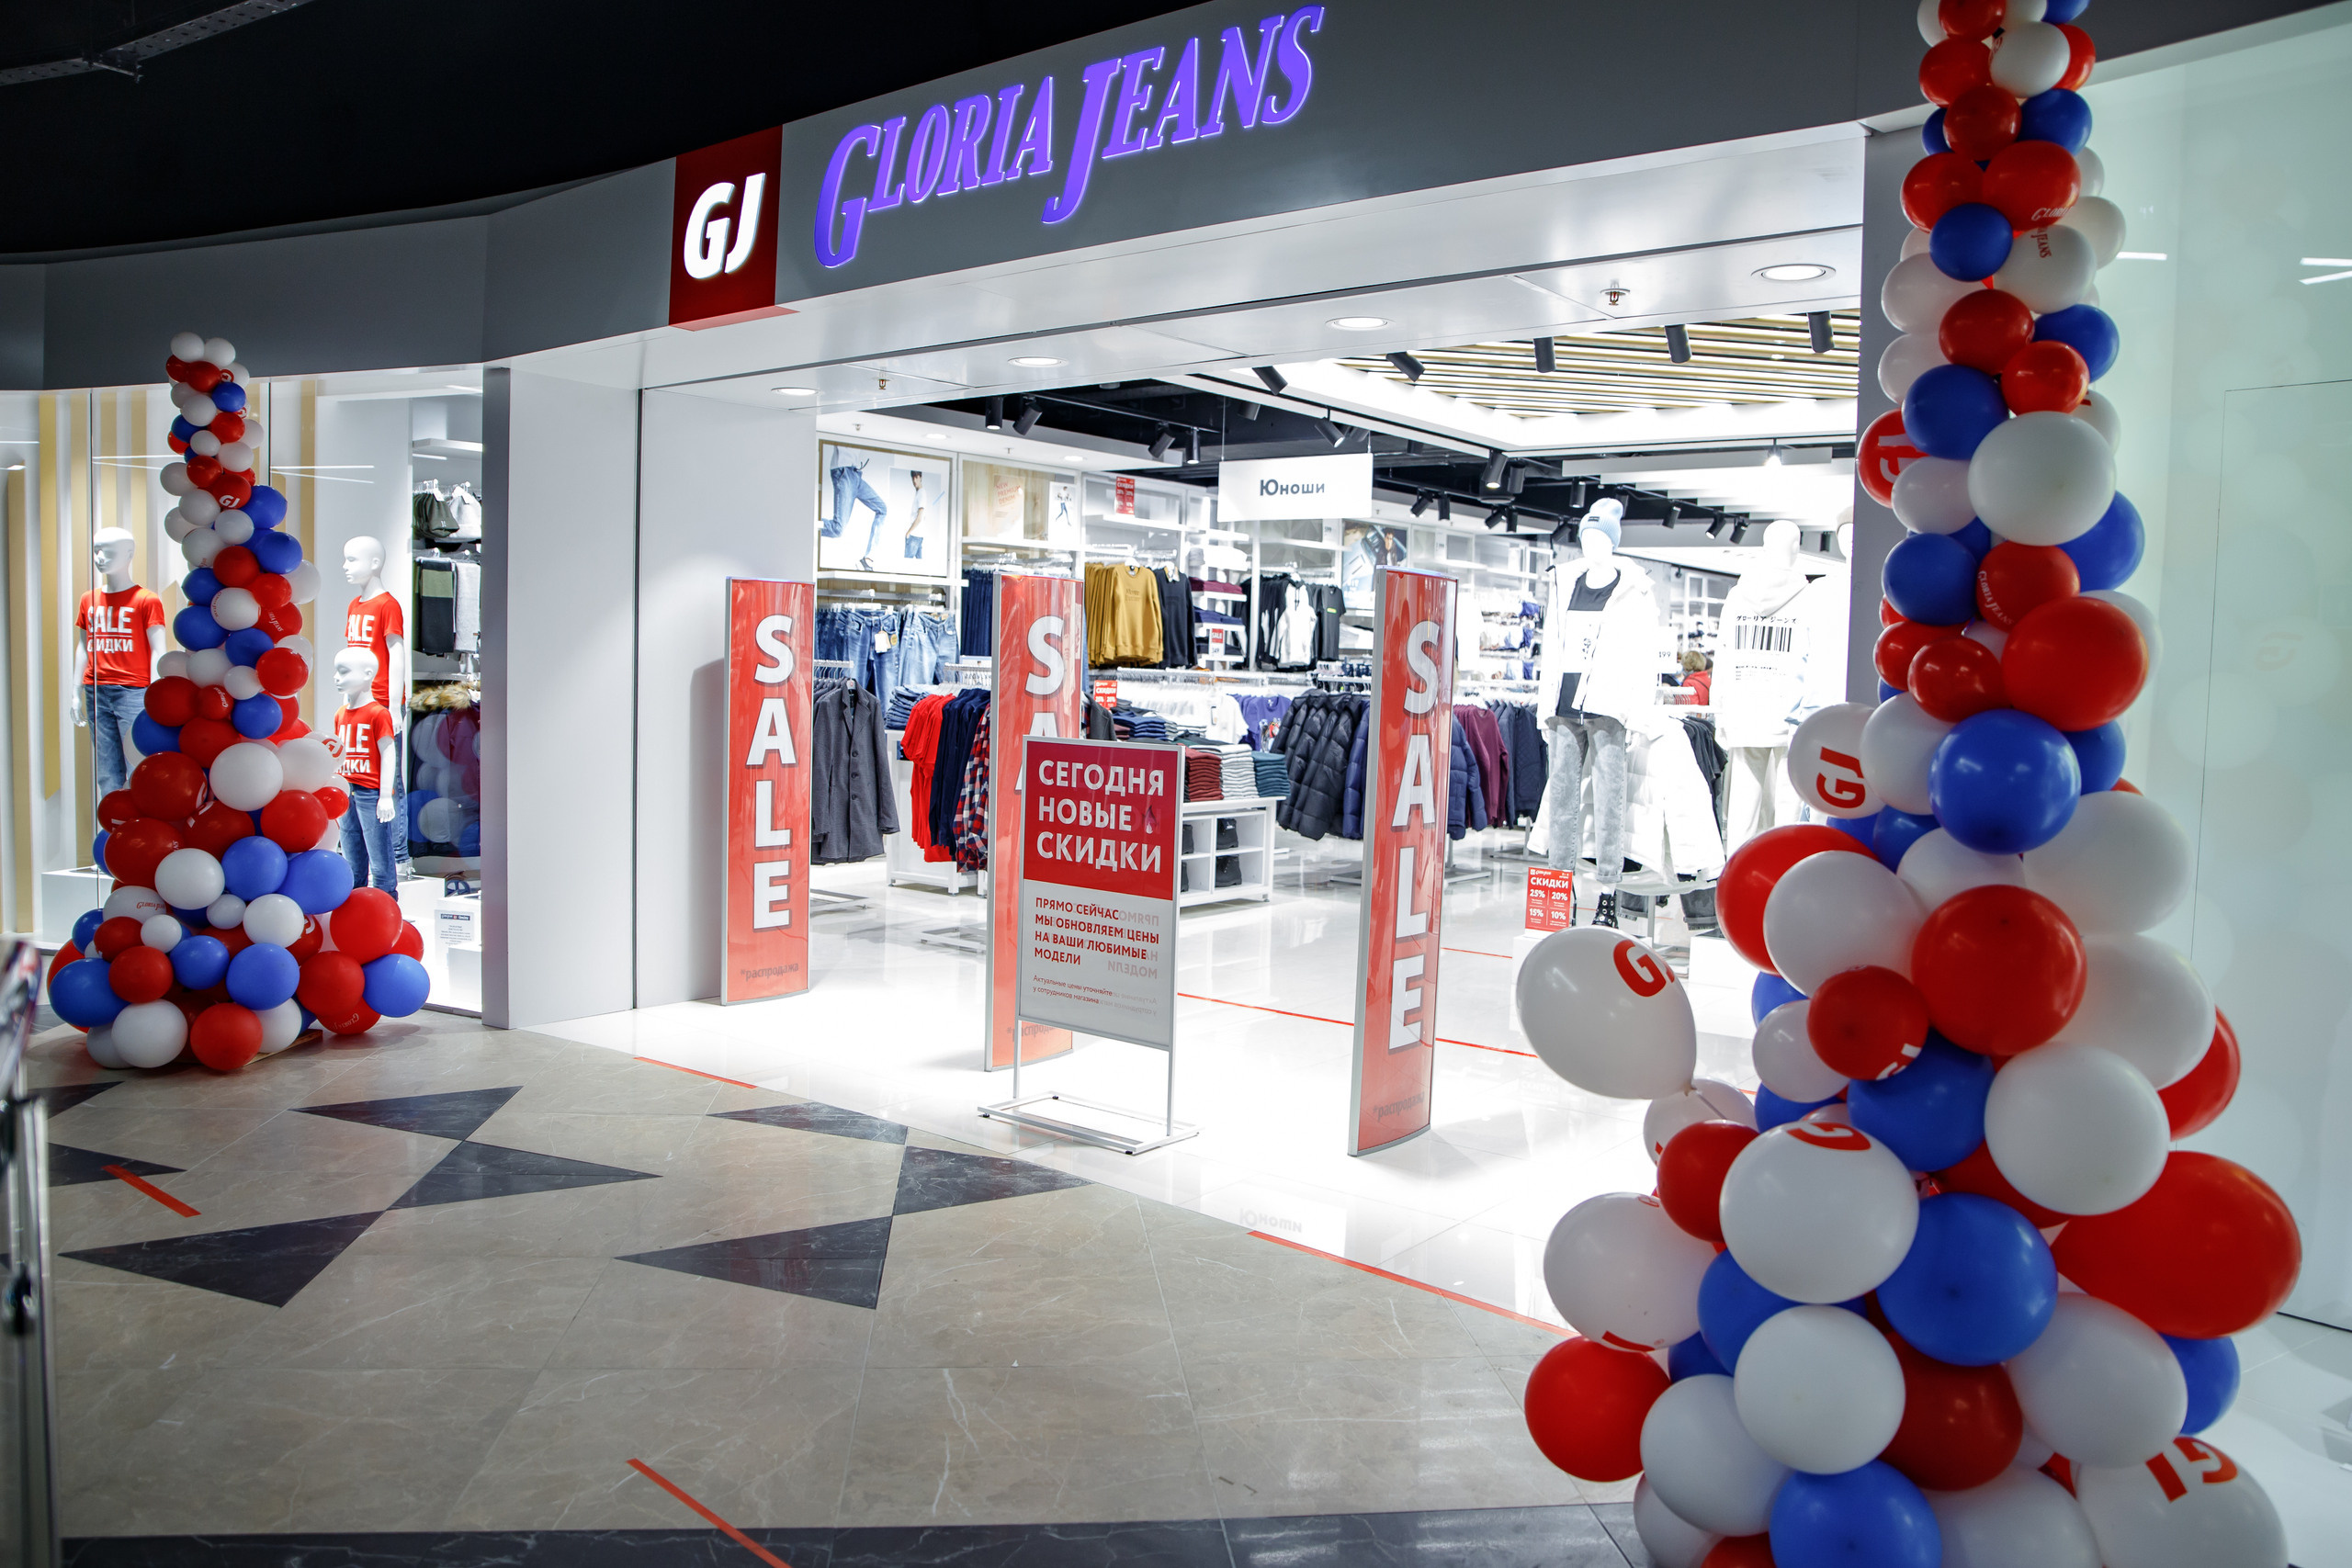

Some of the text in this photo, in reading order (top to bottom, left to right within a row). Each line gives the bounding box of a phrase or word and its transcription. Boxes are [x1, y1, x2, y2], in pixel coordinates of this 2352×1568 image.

[814, 4, 1325, 268] GLORIA JEANS
[683, 172, 766, 280] GJ
[219, 495, 241, 508] GJ
[1260, 479, 1325, 496] Юноши
[348, 614, 375, 642] ALE
[87, 638, 133, 653] СИДКИ
[745, 614, 797, 931] SALE
[1038, 760, 1164, 797] СЕГОДНЯ
[1815, 745, 1866, 809] GJ
[1038, 795, 1132, 831] НОВЫЕ
[1388, 620, 1440, 1051] SALE
[1036, 831, 1161, 874] СКИДКИ
[1530, 876, 1569, 889] СКИДКИ
[1530, 889, 1568, 901] 25% 20%
[1035, 897, 1119, 920] ПРЯМО СЕЙЧАС
[1530, 908, 1544, 918] 15%
[1551, 910, 1566, 920] 10%
[1035, 914, 1159, 944] МЫ ОБНОВЛЯЕМ ЦЕНЫ
[1035, 931, 1147, 960] НА ВАШИ ЛЮБИМЫЕ
[1035, 947, 1081, 965] МОДЕЛИ
[1033, 975, 1113, 997] Актуальные цены уточняйте
[1037, 987, 1073, 999] сотрудников
[1073, 993, 1100, 1004] магазина
